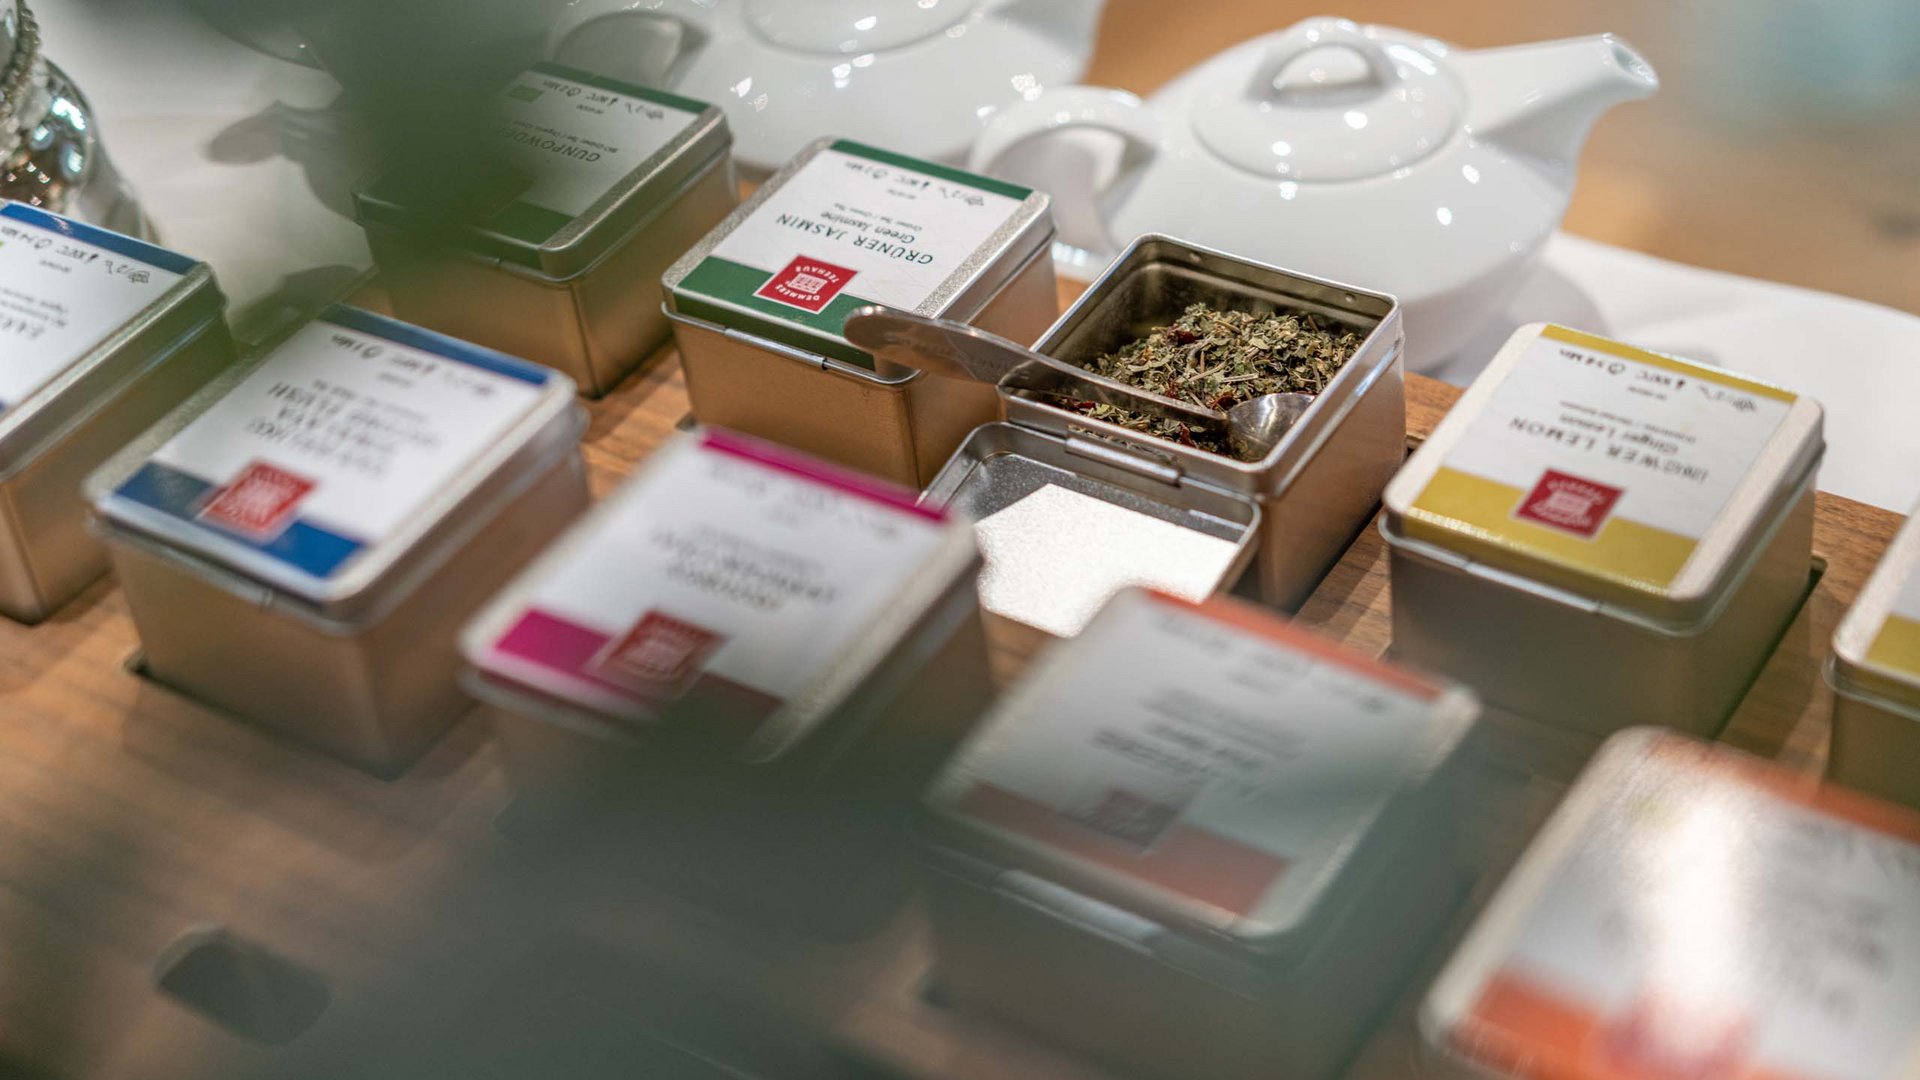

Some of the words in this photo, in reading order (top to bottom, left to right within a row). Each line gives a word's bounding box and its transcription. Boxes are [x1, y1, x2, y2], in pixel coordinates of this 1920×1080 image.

[776, 213, 849, 240] JASMIN
[820, 210, 873, 231] Jasmine
[875, 226, 916, 244] Green
[853, 235, 933, 265] GRÜNER
[795, 265, 840, 283] TEEHAUS
[775, 284, 821, 301] DEMMERS
[1509, 416, 1599, 450] LEMON
[1605, 445, 1710, 483] INGWER
